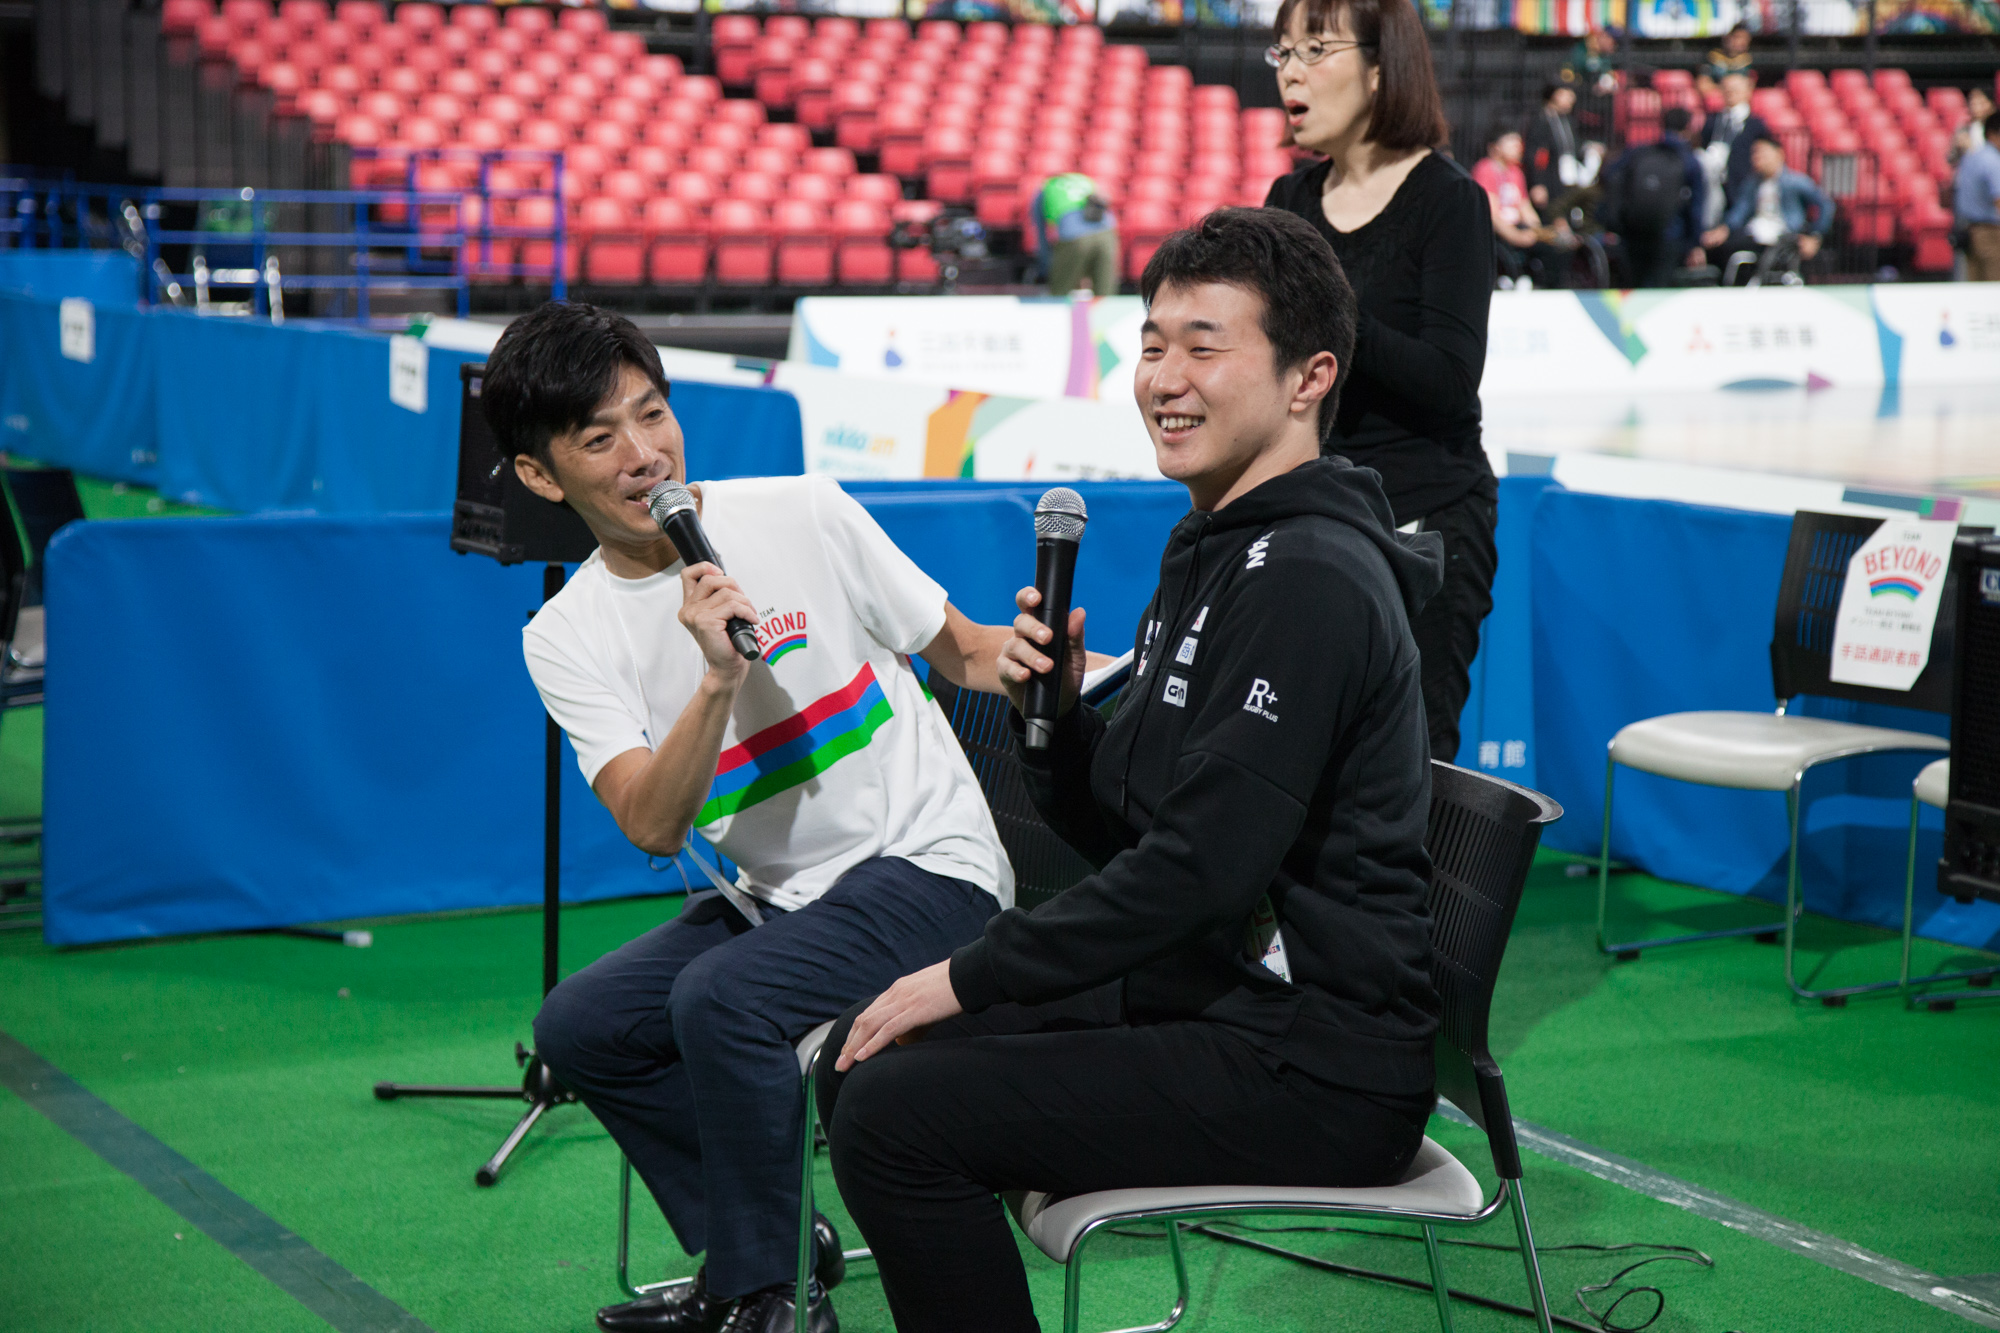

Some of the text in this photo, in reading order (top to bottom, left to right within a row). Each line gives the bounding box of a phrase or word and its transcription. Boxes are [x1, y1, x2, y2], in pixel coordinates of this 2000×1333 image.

[1864, 544, 1942, 580] BEYOND
[760, 606, 775, 618] TEAM
[755, 611, 807, 652] EYOND
[1243, 703, 1279, 723] RUGBY PLUS
